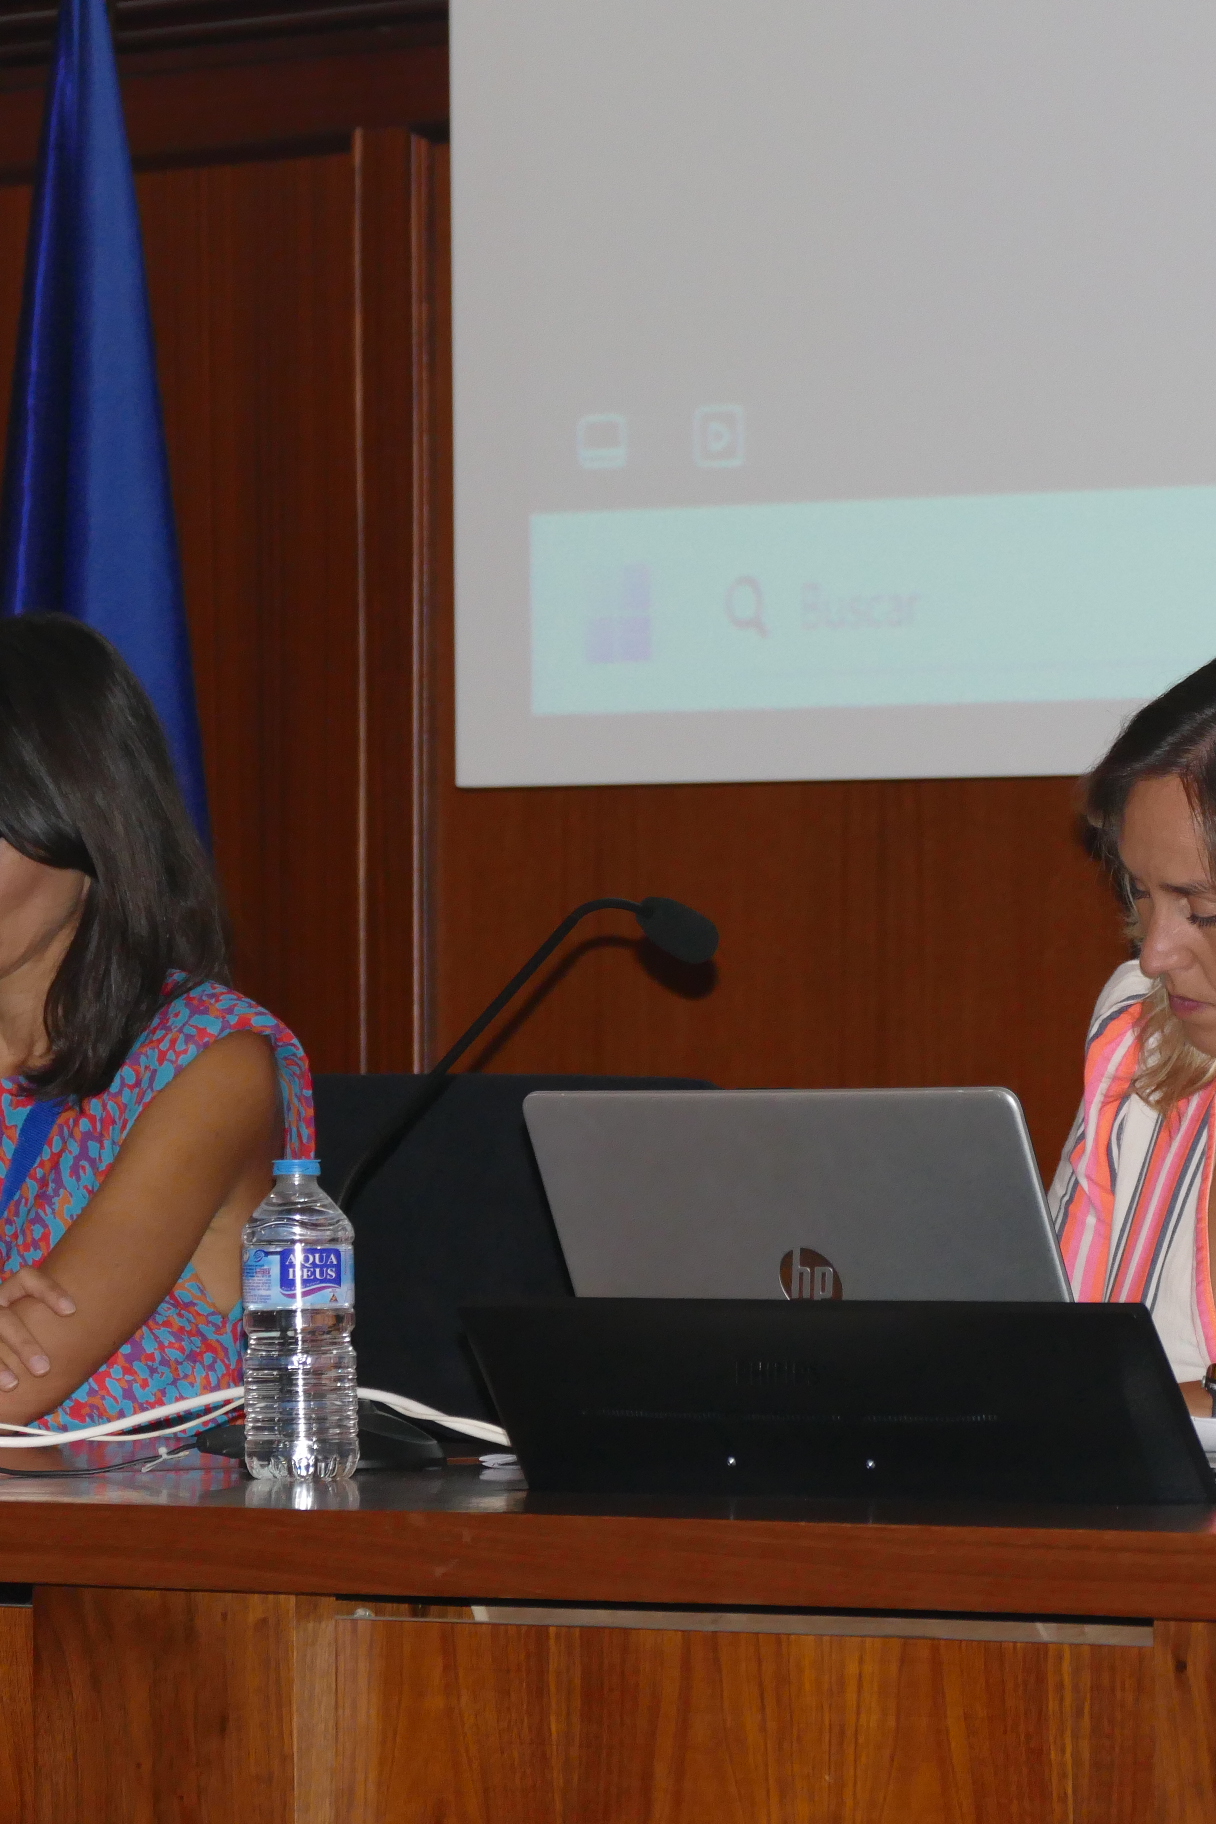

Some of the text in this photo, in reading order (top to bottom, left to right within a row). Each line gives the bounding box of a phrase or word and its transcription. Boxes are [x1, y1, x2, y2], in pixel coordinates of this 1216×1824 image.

[801, 581, 923, 630] Buscar
[286, 1253, 337, 1267] AQUA
[288, 1268, 336, 1279] DEUS
[791, 1248, 833, 1300] hp
